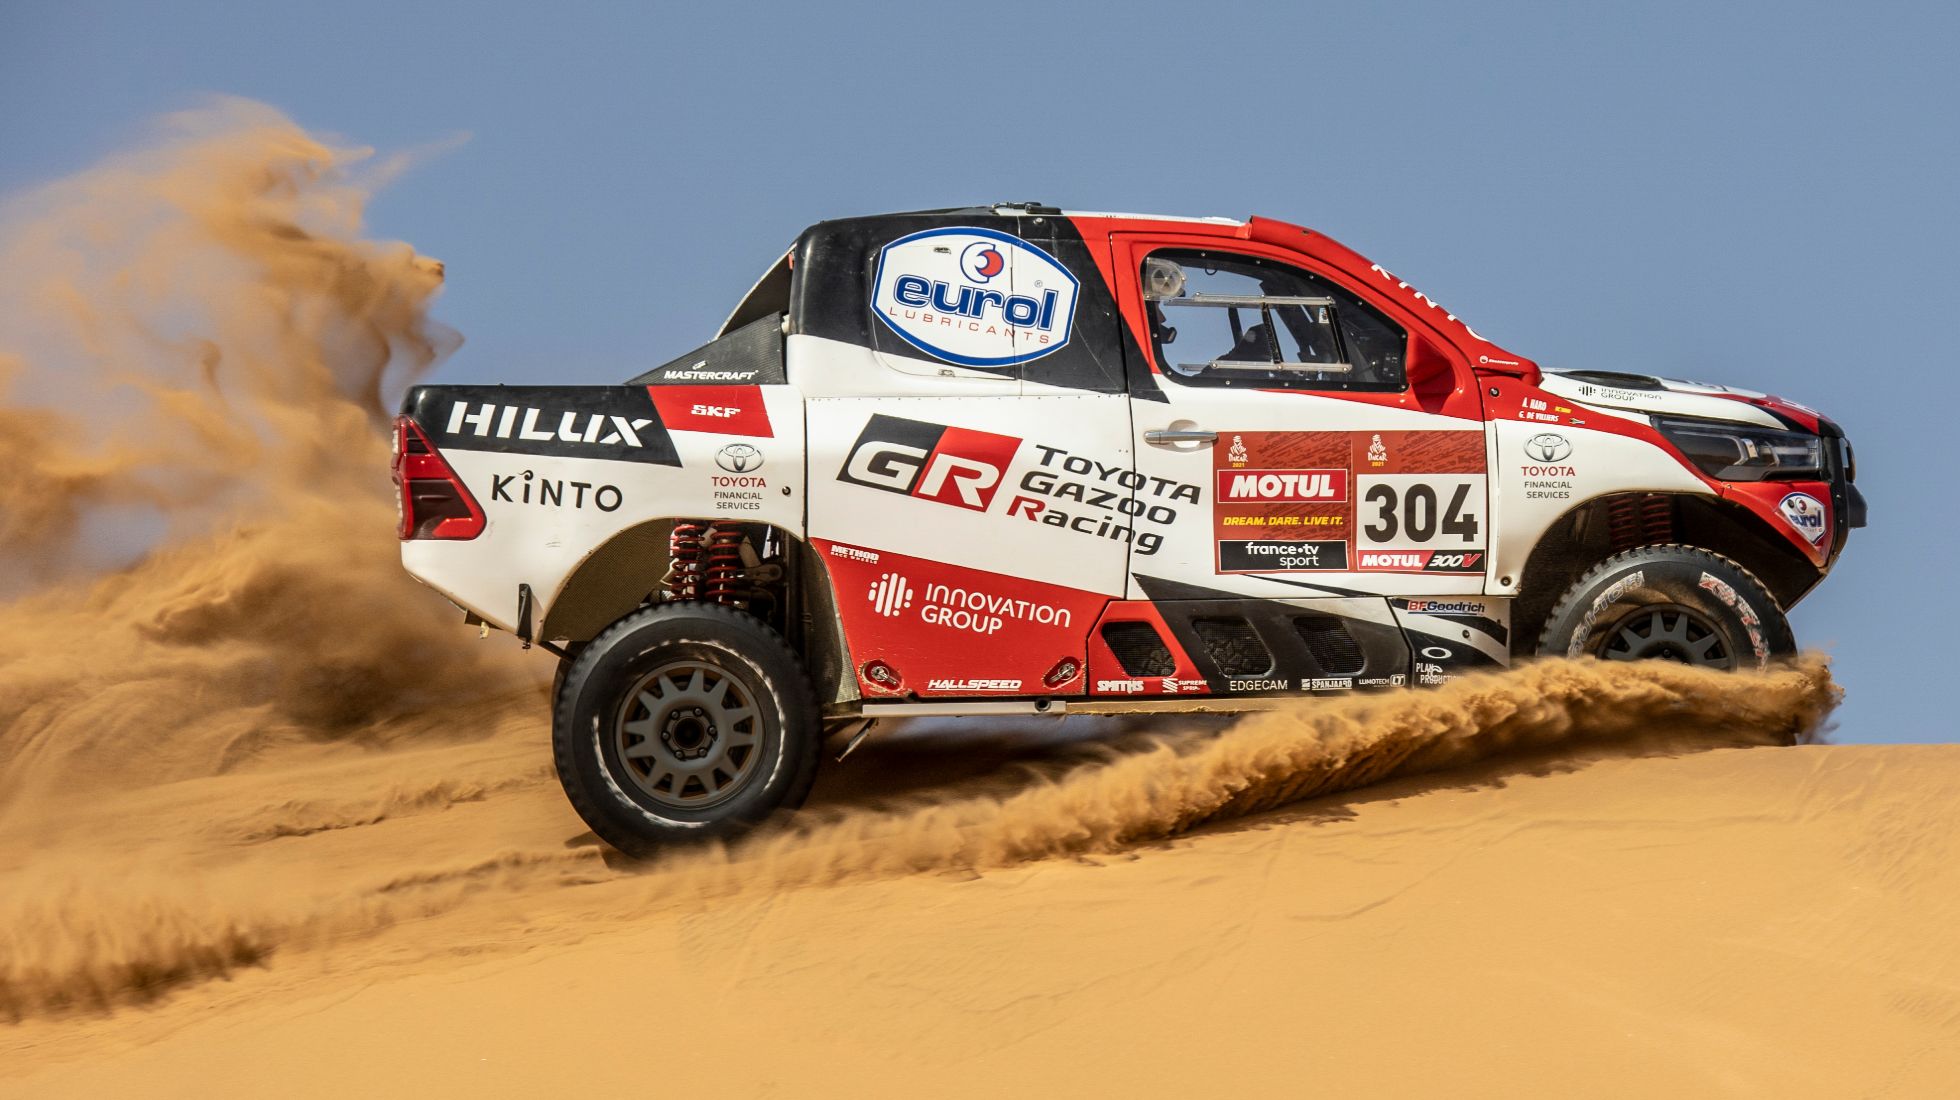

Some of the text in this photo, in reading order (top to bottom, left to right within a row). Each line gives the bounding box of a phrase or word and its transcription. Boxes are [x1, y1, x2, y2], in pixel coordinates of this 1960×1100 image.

[894, 274, 1060, 331] eurol
[889, 306, 1050, 344] LUBRICANTS
[664, 370, 756, 380] MASTERCRAFT
[1601, 392, 1635, 401] GROUP
[691, 404, 741, 418] SKF
[446, 401, 653, 448] HILUX
[847, 440, 1000, 508] GR
[1035, 444, 1202, 505] TOYOTA
[1520, 466, 1575, 477] TOYOTA
[711, 476, 767, 489] TOYOTA
[1229, 475, 1335, 498] MOTUL
[1524, 481, 1573, 489] FINANCIAL
[713, 491, 763, 500] FINANCIAL
[1019, 471, 1177, 526] GAZOO
[1526, 490, 1570, 499] SERVICES
[716, 502, 761, 510] SERVICES
[1364, 483, 1479, 543] 304
[1006, 495, 1165, 556] Racing
[1223, 516, 1344, 525] DREAM. DARE. LIVE IT.
[831, 545, 880, 561] METHOD
[1279, 556, 1320, 569] sport
[1362, 553, 1482, 568] MOTUL 300V
[925, 583, 1071, 628] INNOVATION
[1407, 600, 1485, 613] BFGoodrich
[921, 604, 1003, 635] GROUP
[928, 679, 1022, 689] HALLSPEED
[1097, 679, 1144, 694] SMITHS
[1230, 679, 1288, 691] EDGECAM
[1311, 679, 1353, 689] SPANJAARD
